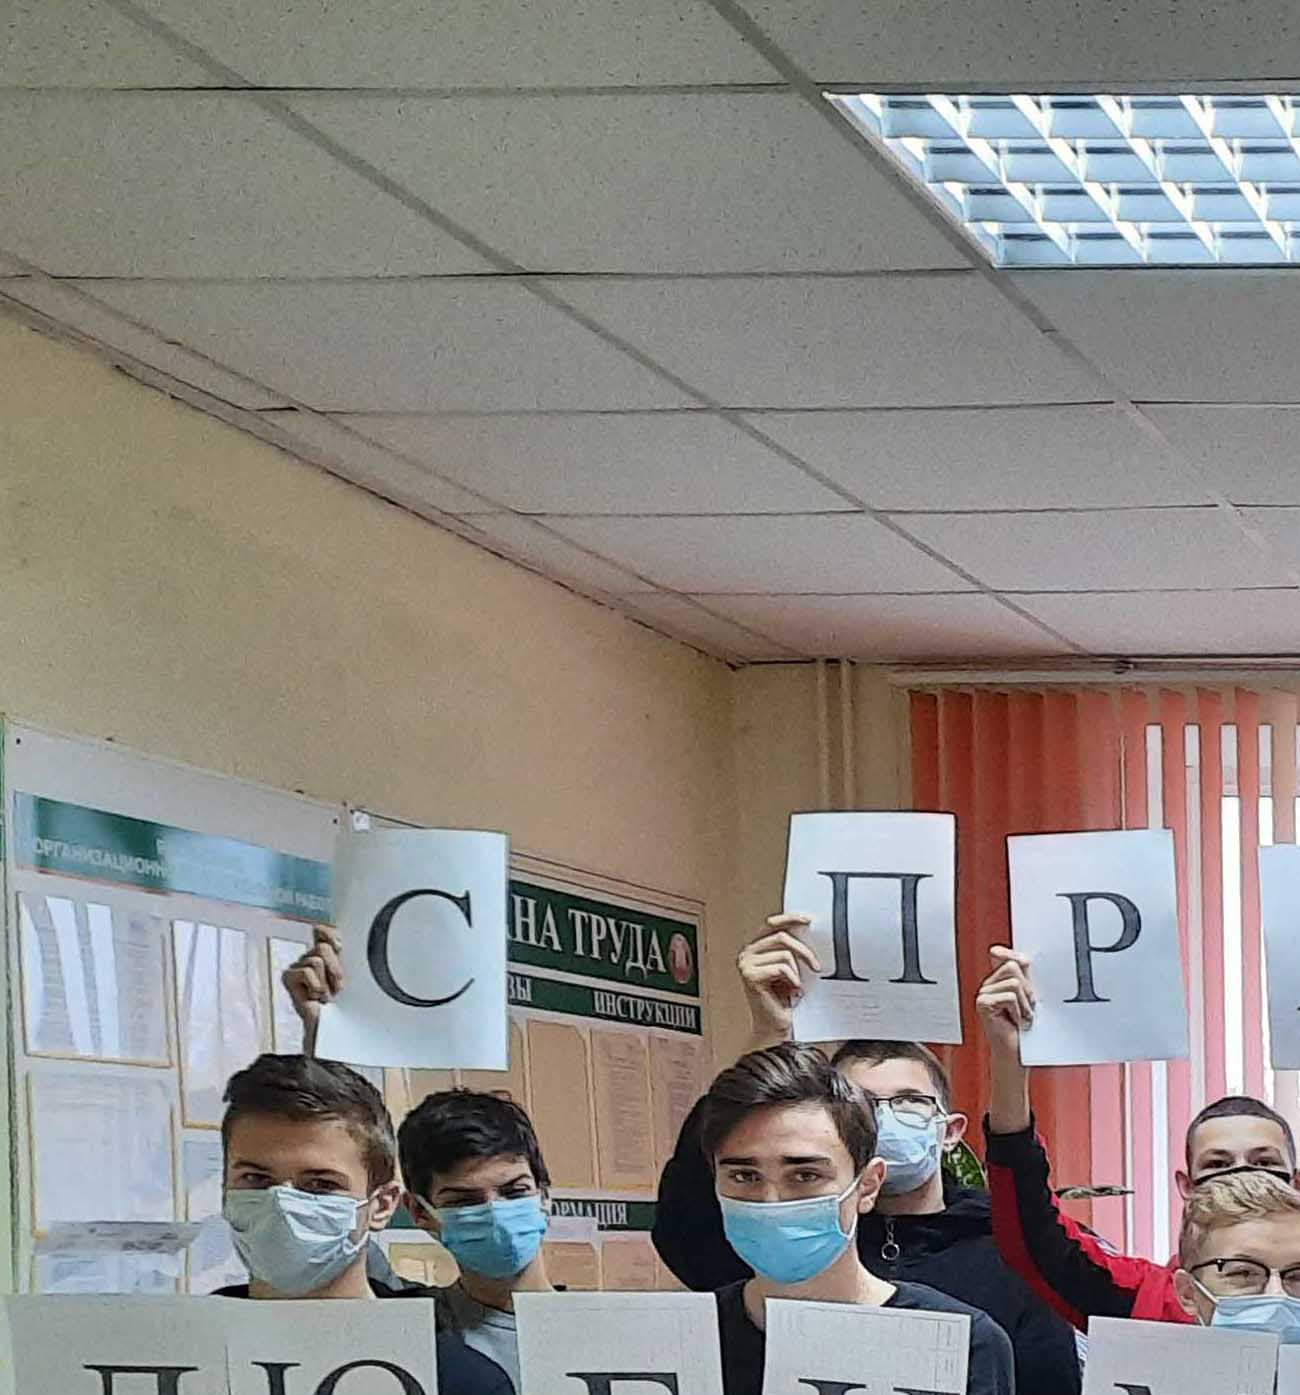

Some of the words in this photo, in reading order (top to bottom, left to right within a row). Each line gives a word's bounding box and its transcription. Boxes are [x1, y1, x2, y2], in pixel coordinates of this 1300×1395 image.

[367, 889, 476, 1008] С
[818, 872, 935, 984] П
[1057, 893, 1141, 1003] Р
[568, 908, 667, 979] ТРУДА
[593, 990, 697, 1029] ИНСТРУКЦИИ
